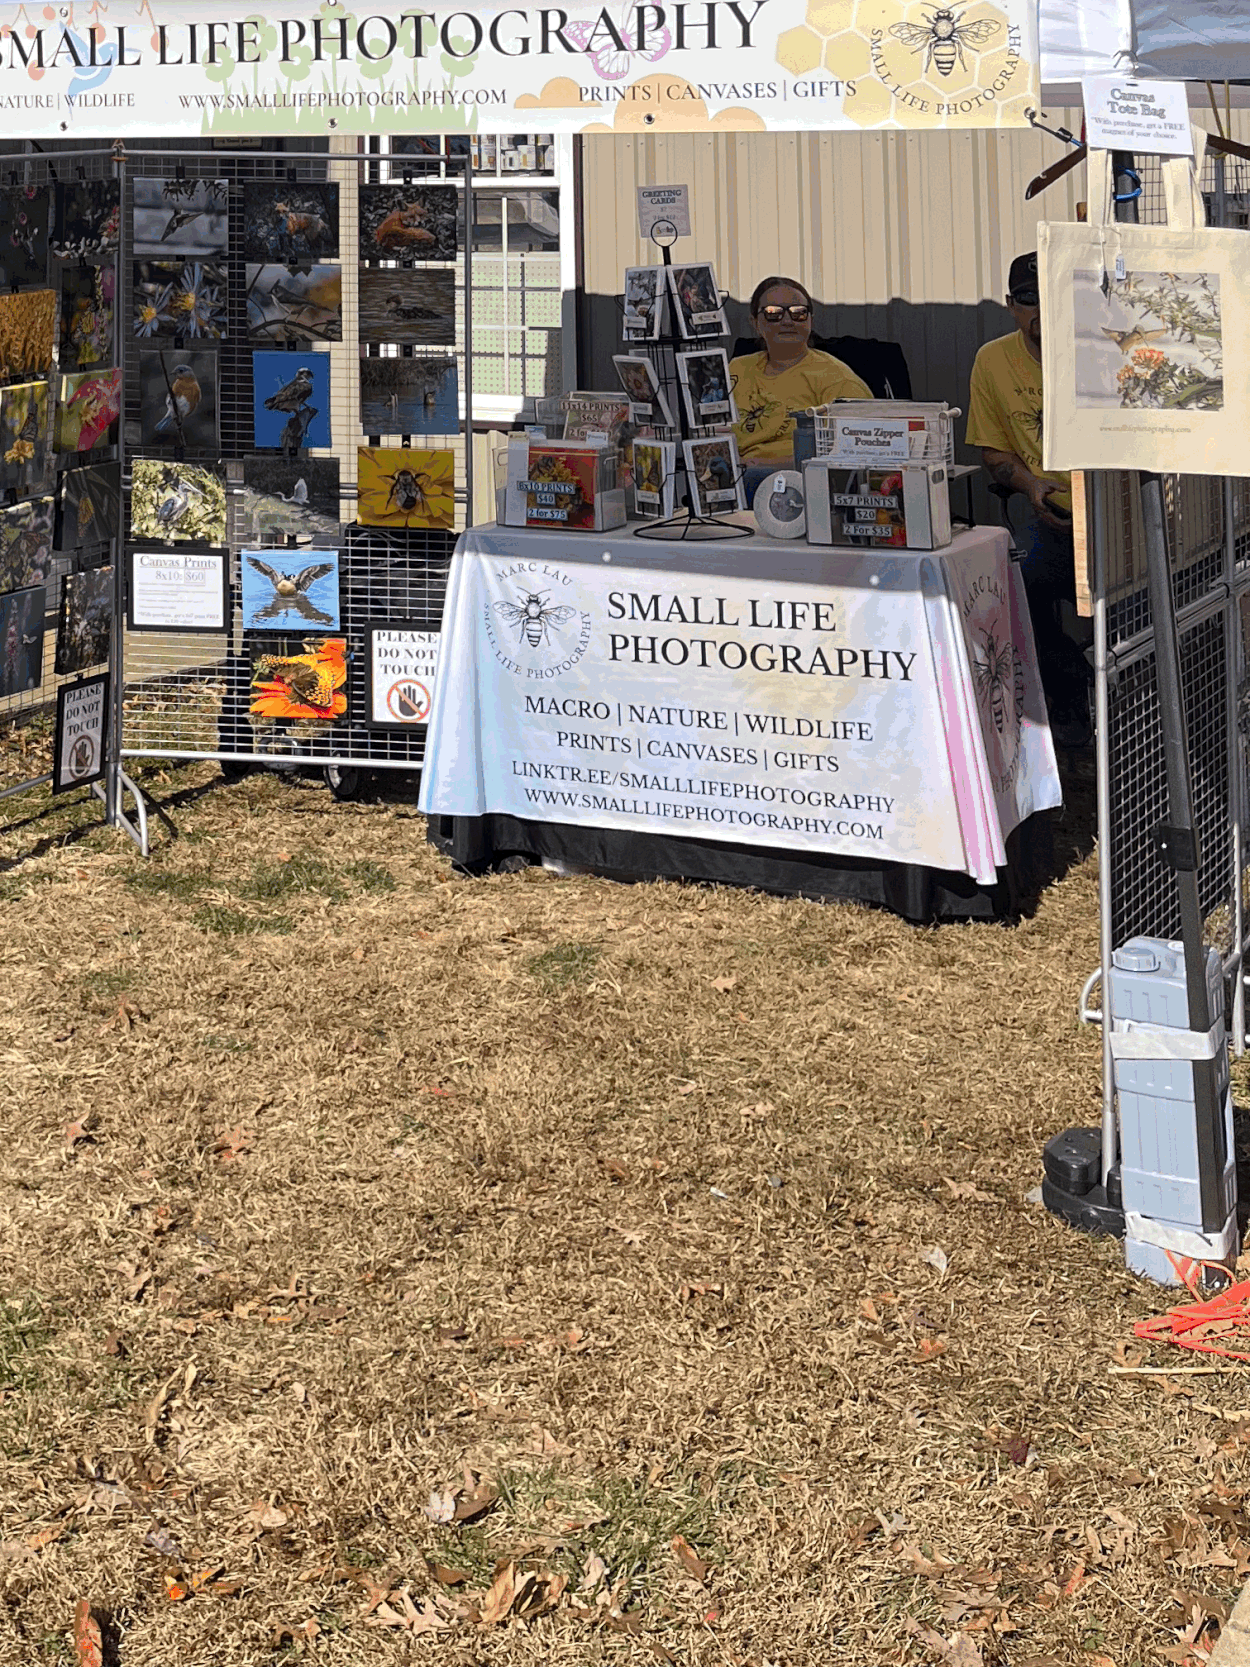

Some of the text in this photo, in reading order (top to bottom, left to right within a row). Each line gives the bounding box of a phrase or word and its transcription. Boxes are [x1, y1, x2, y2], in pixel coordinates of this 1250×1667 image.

[156, 21, 261, 66] LIFE
[870, 23, 1022, 116] SMALL LIFE PHOTOGRAPHY
[578, 79, 857, 103] PRINTS CANVASES GIFTS
[1110, 88, 1155, 102] Canvas
[64, 92, 136, 108] WILDLIFE
[179, 88, 507, 110] WWW.SMALLLIFEPHOTOGRAPHY.COM
[1107, 100, 1167, 120] Tote Bag
[642, 189, 682, 198] GREETING
[561, 401, 620, 412] 11x14 PRINTS
[581, 413, 598, 422] $65
[841, 426, 905, 439] Canvas Zipper
[854, 436, 891, 447] Pouches
[542, 482, 573, 493] PRINTS
[538, 493, 554, 503] $40
[836, 495, 894, 507] 5x7 PRINTS
[550, 509, 566, 519] $75
[856, 509, 876, 520] $20
[844, 525, 851, 534] 2
[872, 526, 891, 536] $35
[139, 555, 217, 569] Canvas Prints
[185, 570, 204, 582] $60
[496, 562, 573, 586] MARC LAU
[607, 591, 837, 632] SMALL LIFE
[377, 631, 438, 644] PLEASE
[495, 650, 522, 675] LIFE
[526, 611, 591, 680] PHOTOGRAPHY
[378, 647, 438, 660] DO NOT
[608, 633, 918, 682] PHOTOGRAPHY
[380, 663, 436, 677] TOUCH
[66, 684, 102, 704] PLEASE
[66, 700, 101, 721] DO NOT
[524, 695, 874, 742] MACRO NATURE WILDLIFE
[66, 717, 99, 736] TOUCH
[556, 731, 840, 772] PRINTS CANVASES GIFTS
[512, 760, 895, 814] LINKTR.EE/SMALLLIFEPHOTOGRAPHY
[524, 787, 885, 840] WWW.SMALLLIFEPHOTOGRAPHY.COM
